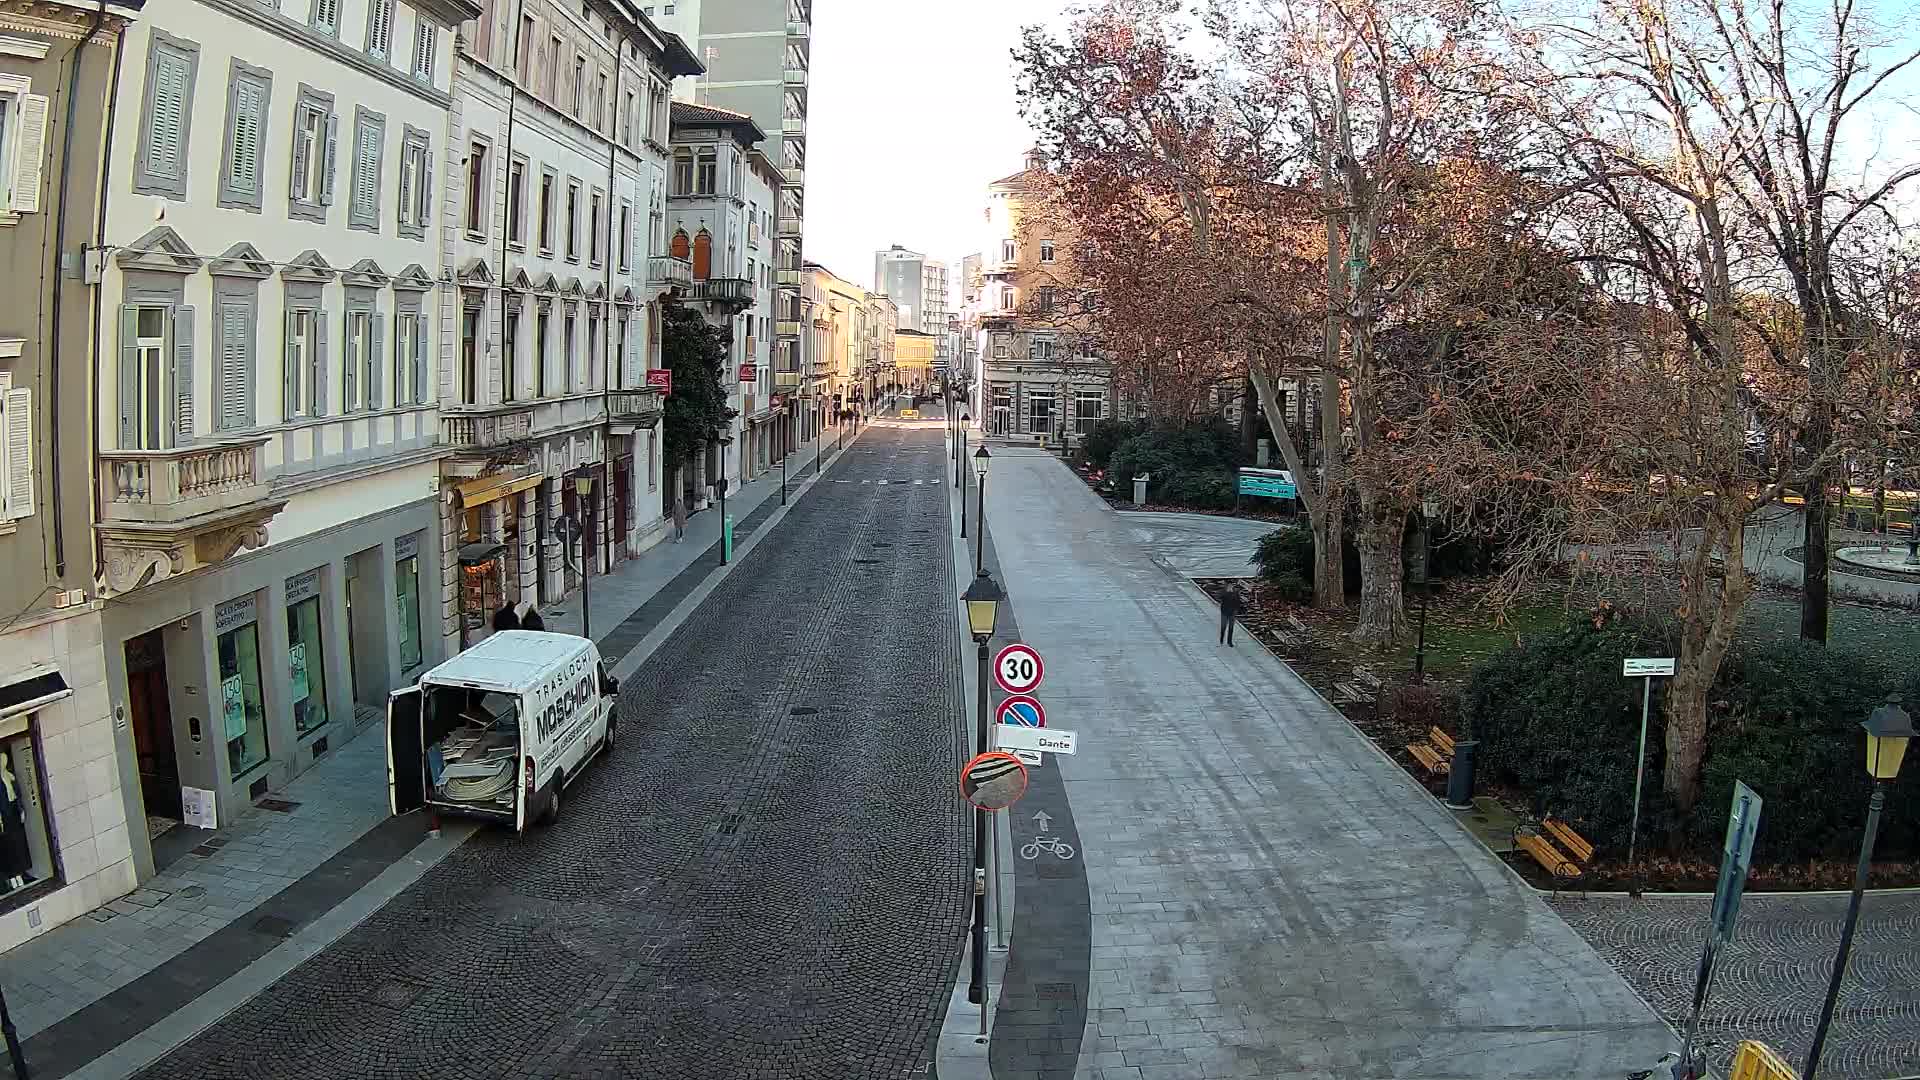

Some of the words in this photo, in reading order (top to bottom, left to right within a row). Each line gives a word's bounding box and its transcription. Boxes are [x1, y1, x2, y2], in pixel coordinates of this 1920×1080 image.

[536, 652, 591, 701] TRASLOCHI
[1006, 659, 1033, 680] 30
[536, 671, 596, 744] MOSCHION
[1039, 738, 1070, 749] Dante
